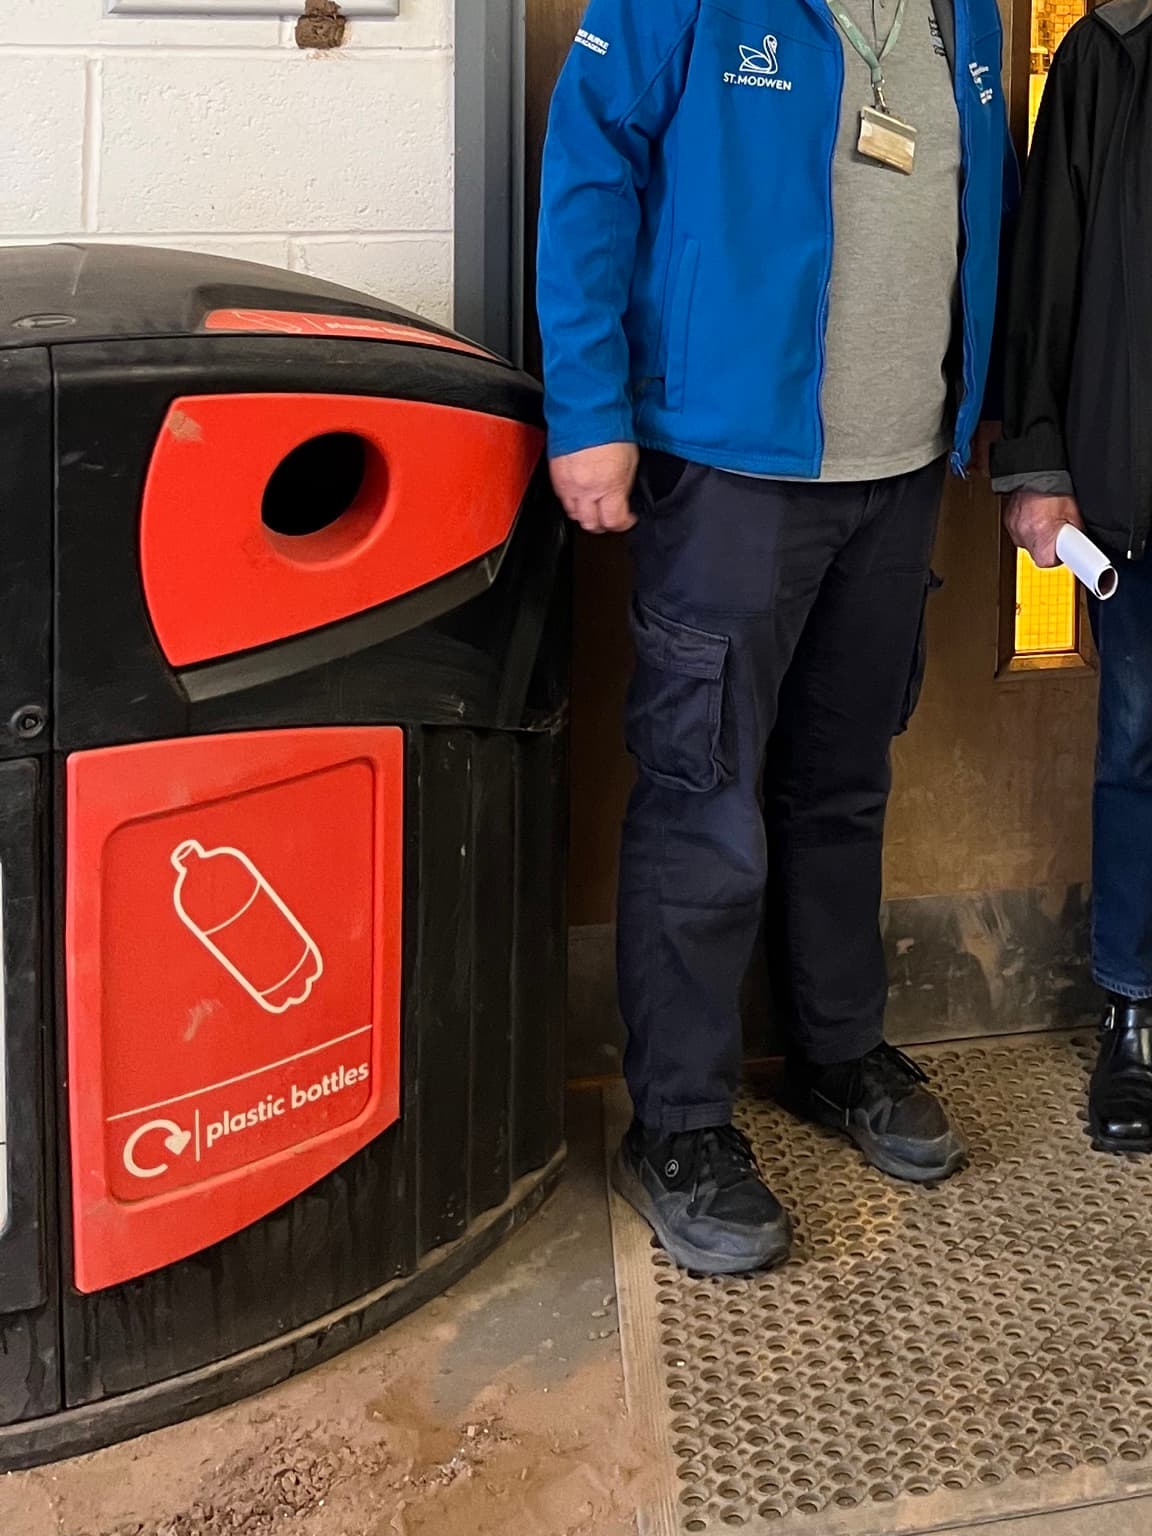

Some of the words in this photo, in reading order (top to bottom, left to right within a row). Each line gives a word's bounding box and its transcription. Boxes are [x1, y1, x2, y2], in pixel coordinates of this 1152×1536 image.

[723, 72, 792, 91] ST.MODWEN
[206, 1094, 286, 1149] plastic
[290, 1062, 370, 1109] bottles
